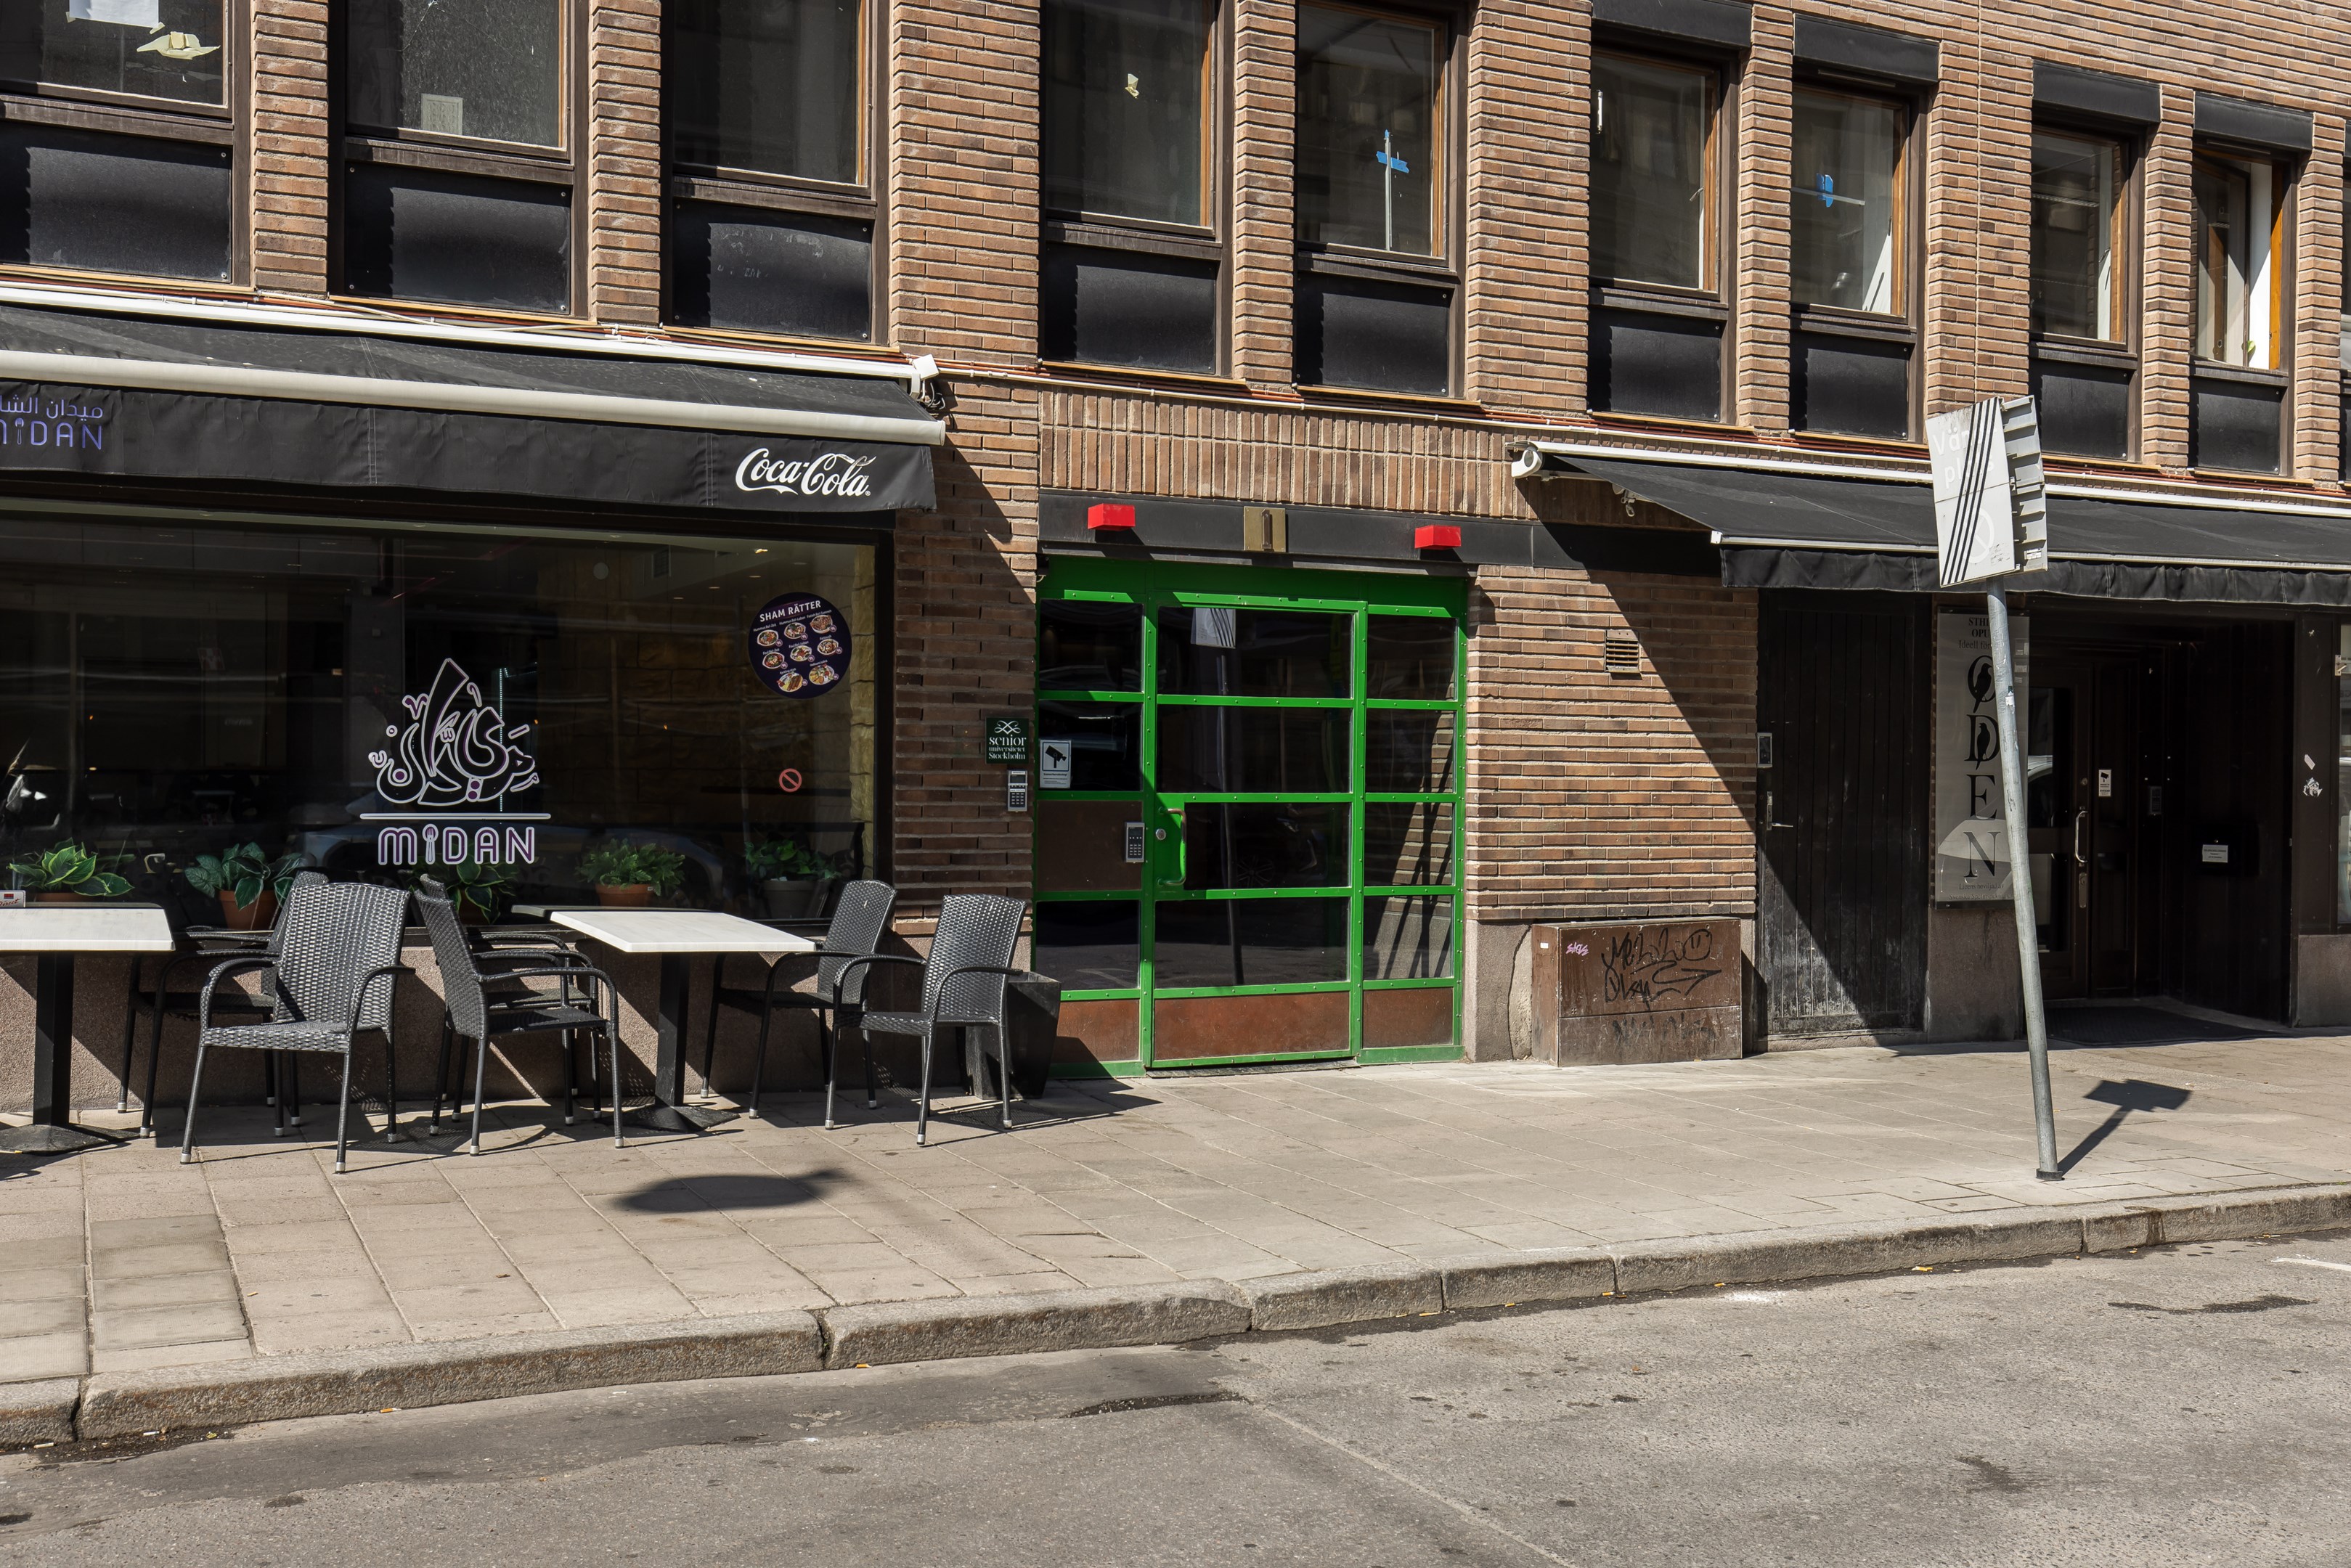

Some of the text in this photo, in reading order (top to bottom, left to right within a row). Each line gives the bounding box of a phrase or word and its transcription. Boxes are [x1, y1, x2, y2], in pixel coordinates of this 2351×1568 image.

[0, 417, 102, 450] IDAN
[735, 447, 877, 497] Coca-Cola
[759, 600, 821, 622] SHAM RÄTTER
[1959, 640, 1979, 649] Ideell
[989, 735, 1027, 746] senior
[1963, 655, 2002, 878] ODEN
